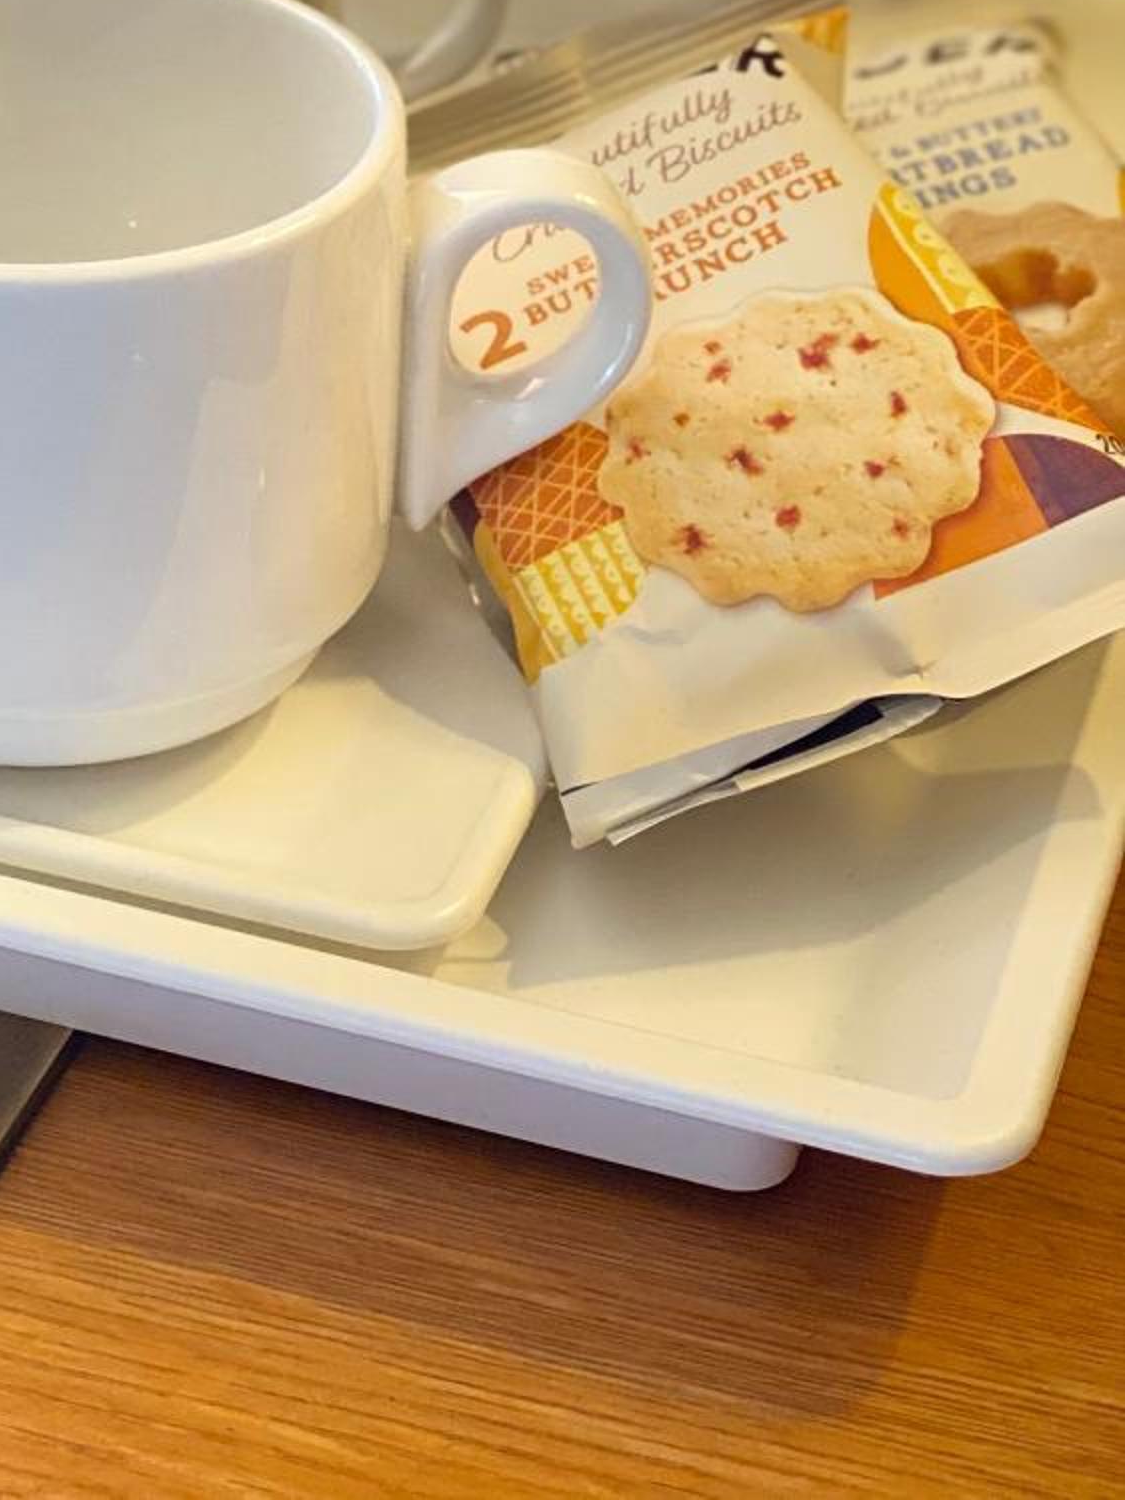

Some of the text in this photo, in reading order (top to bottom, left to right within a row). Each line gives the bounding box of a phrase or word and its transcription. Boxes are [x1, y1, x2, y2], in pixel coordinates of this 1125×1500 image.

[591, 88, 733, 167] utifully
[646, 100, 803, 184] Biscuits
[527, 254, 595, 295] SWE
[643, 151, 812, 241] MEMORIES
[914, 166, 1017, 210] INGS
[654, 220, 789, 301] UNCH
[460, 310, 528, 371] 2
